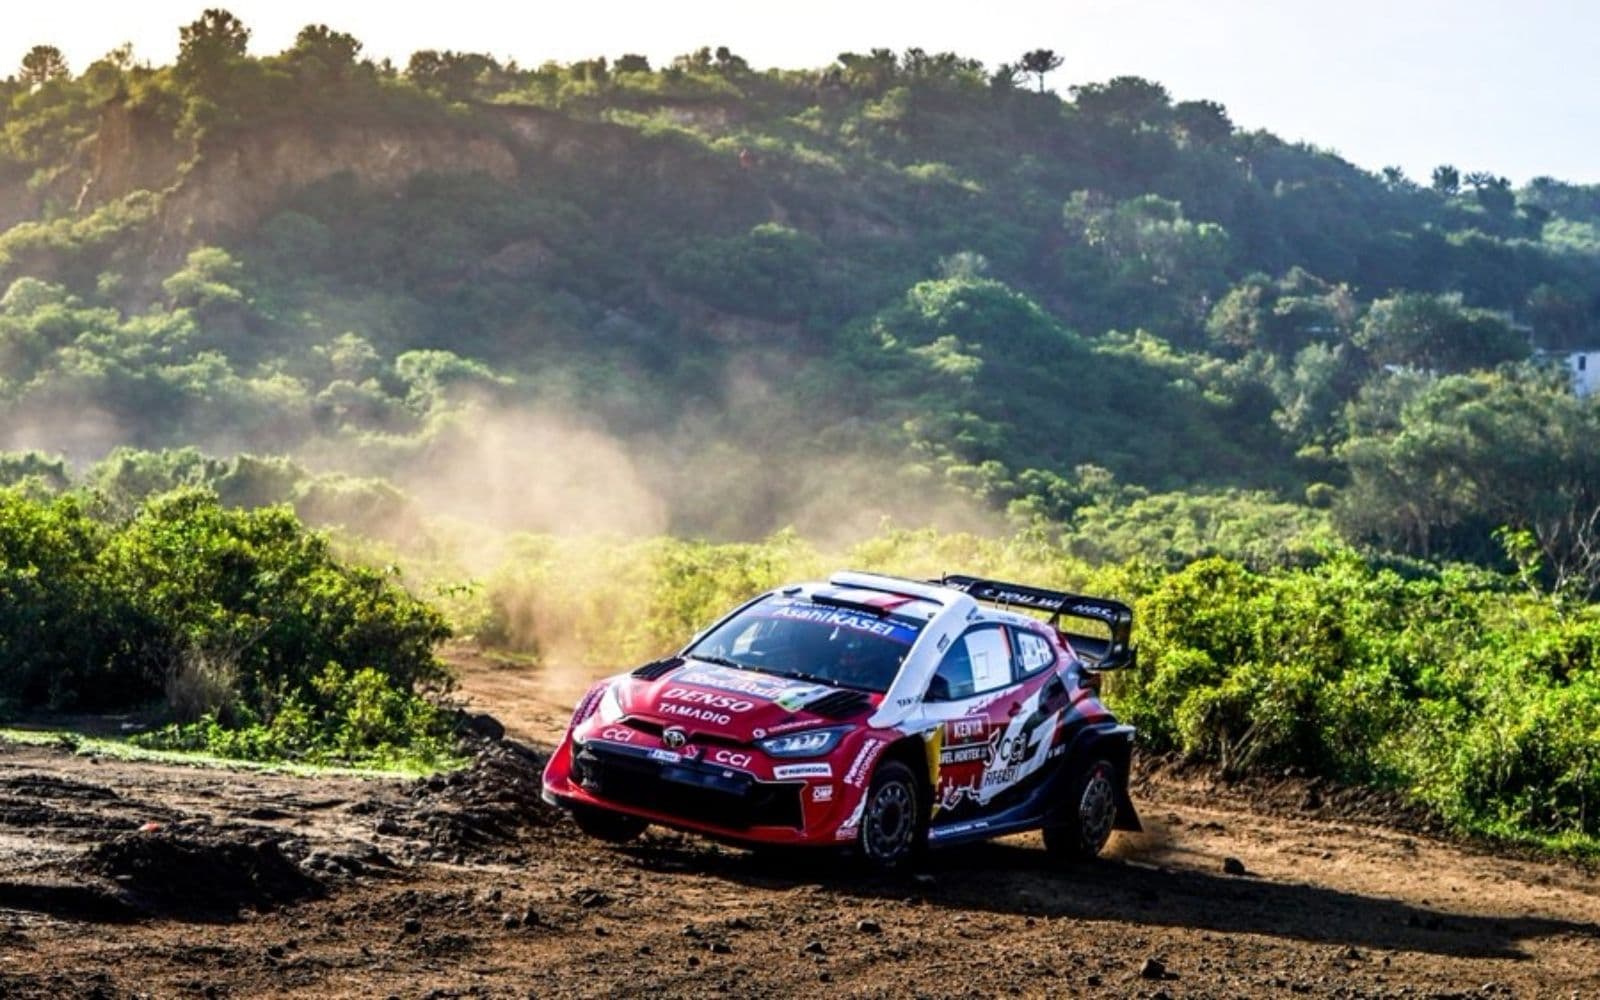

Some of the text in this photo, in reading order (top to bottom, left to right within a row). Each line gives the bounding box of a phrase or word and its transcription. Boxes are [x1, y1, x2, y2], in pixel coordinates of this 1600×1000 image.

[661, 688, 754, 712] DENSO
[658, 703, 731, 725] TAMADIC
[602, 728, 635, 742] CCI
[953, 719, 984, 738] KENYA
[715, 750, 752, 768] CCI
